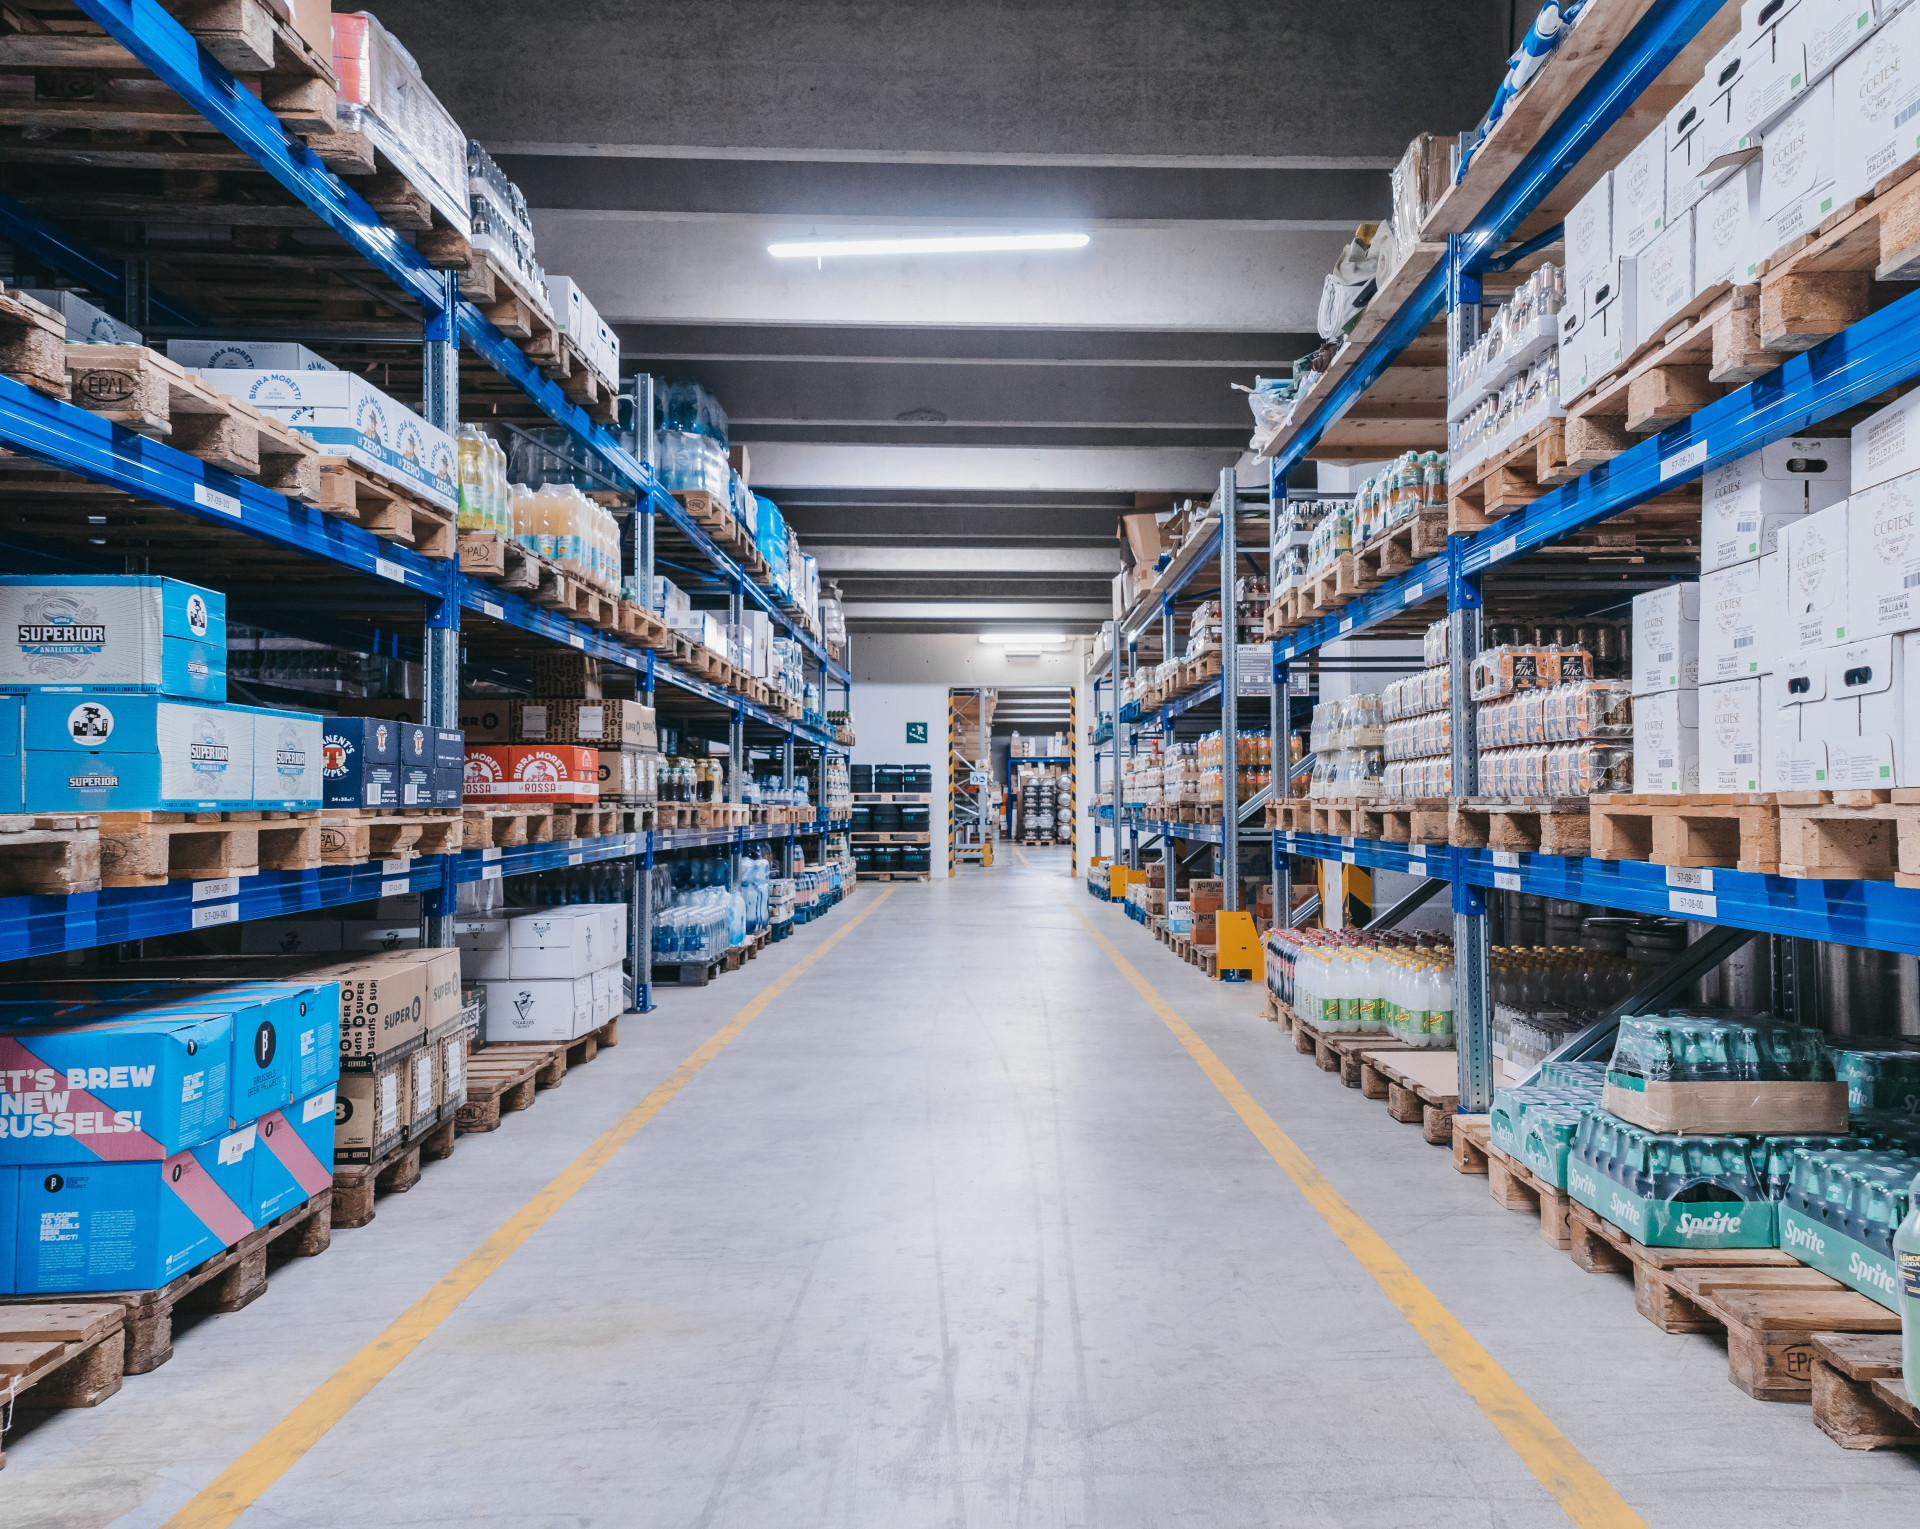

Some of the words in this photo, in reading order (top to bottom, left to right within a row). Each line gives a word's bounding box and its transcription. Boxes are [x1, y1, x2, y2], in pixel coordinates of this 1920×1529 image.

[1859, 56, 1902, 99] CORTESE
[1772, 131, 1806, 167] CORTESE
[208, 349, 226, 368] BIRRA
[88, 376, 129, 395] EPAL
[248, 377, 269, 400] BIRRA
[271, 374, 302, 400] MORETTI
[356, 395, 369, 426] BIRRA
[369, 395, 389, 443] MORETTI
[363, 437, 382, 458] ZERO
[396, 420, 408, 449] BIRRA
[408, 419, 426, 464] MORETTI
[430, 442, 441, 469] BIRRA
[1671, 452, 1695, 471] 57-08-20
[402, 459, 420, 479] ZERO
[436, 480, 453, 497] ZERO
[1714, 480, 1741, 499] CORTESE
[206, 492, 230, 509] 57-09-20
[1873, 512, 1915, 537] CORTESE
[1797, 549, 1826, 570] CORTESE
[1715, 596, 1742, 612] CORTESE
[1879, 601, 1909, 614] ITALIANA
[19, 626, 105, 642] SUPERIOR
[39, 645, 84, 654] ANALCOLICA
[1715, 713, 1740, 725] CORTESE
[191, 745, 228, 762] SUPERIOR
[277, 751, 306, 766] SUPERIOR
[471, 752, 503, 779] MORETTI
[513, 754, 535, 779] BIRRA
[536, 751, 568, 779] MORETTI
[69, 777, 119, 788] SUPERIOR
[525, 783, 556, 793] ROSSA
[1676, 872, 1701, 884] 57-08-10
[205, 884, 228, 895] 57-09-10
[1680, 897, 1704, 910] 57-08-00
[204, 910, 228, 921] 57-09-00
[356, 982, 365, 1014] SUPER
[434, 980, 451, 1001] SUPER
[343, 1004, 351, 1037] SUPER
[384, 1006, 411, 1031] SUPER
[461, 1007, 478, 1025] FORST
[367, 1017, 376, 1050] SUPER
[67, 1065, 156, 1090] BREW
[248, 1085, 259, 1097] BEER
[260, 1076, 281, 1092] PROJECT
[253, 1069, 277, 1084] BRUSSELS
[1, 1091, 70, 1116] NEW
[1848, 1087, 1868, 1107] rite
[1496, 1122, 1514, 1142] Sprite
[1570, 1168, 1597, 1198] Sprite
[41, 1211, 79, 1219] WELCOME
[1611, 1192, 1640, 1225] Sprite
[40, 1222, 80, 1230] BRUSSELS
[1676, 1210, 1741, 1239] Sprite
[40, 1234, 78, 1242] PROJECT!
[1784, 1218, 1825, 1256] Sprite
[1848, 1251, 1896, 1295] Sprite
